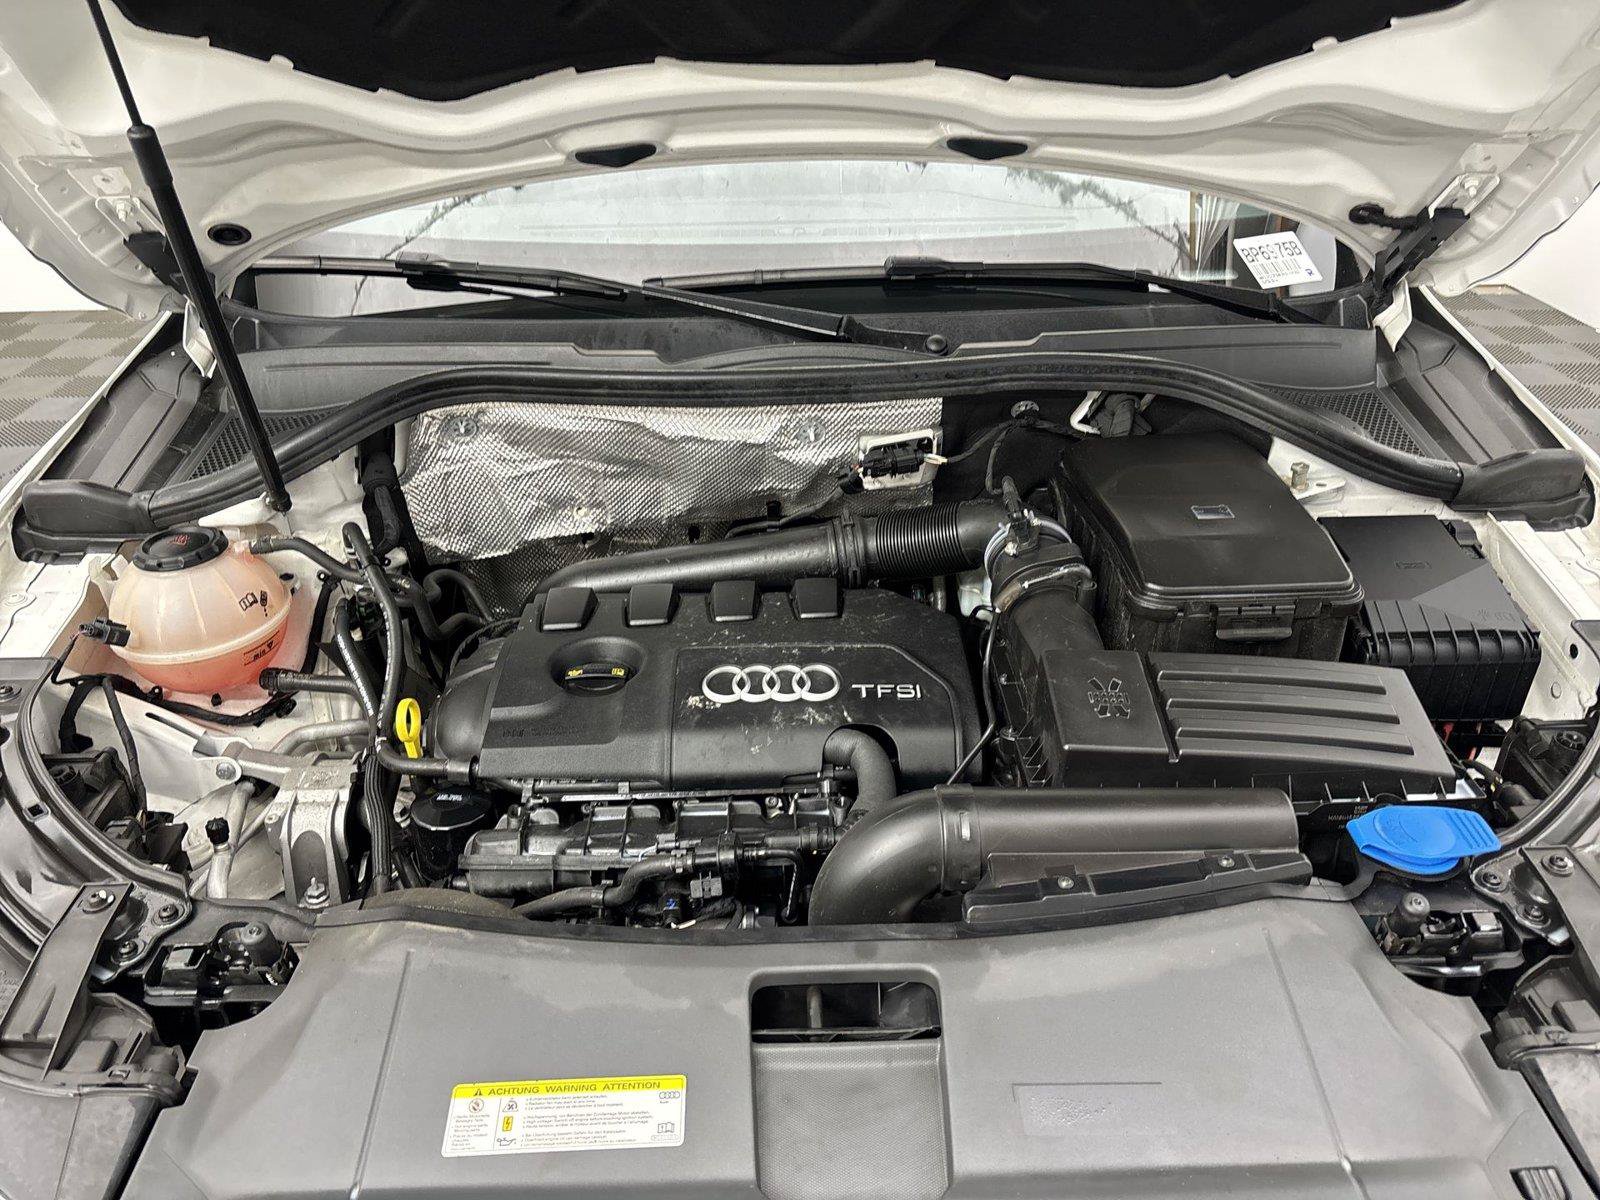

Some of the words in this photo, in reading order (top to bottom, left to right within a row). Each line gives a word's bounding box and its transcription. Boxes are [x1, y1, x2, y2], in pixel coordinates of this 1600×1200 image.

[851, 684, 923, 699] TFSI
[488, 1086, 540, 1096] ACHTUNG
[545, 1083, 597, 1093] WARNING
[603, 1081, 661, 1091] ATTENTION
